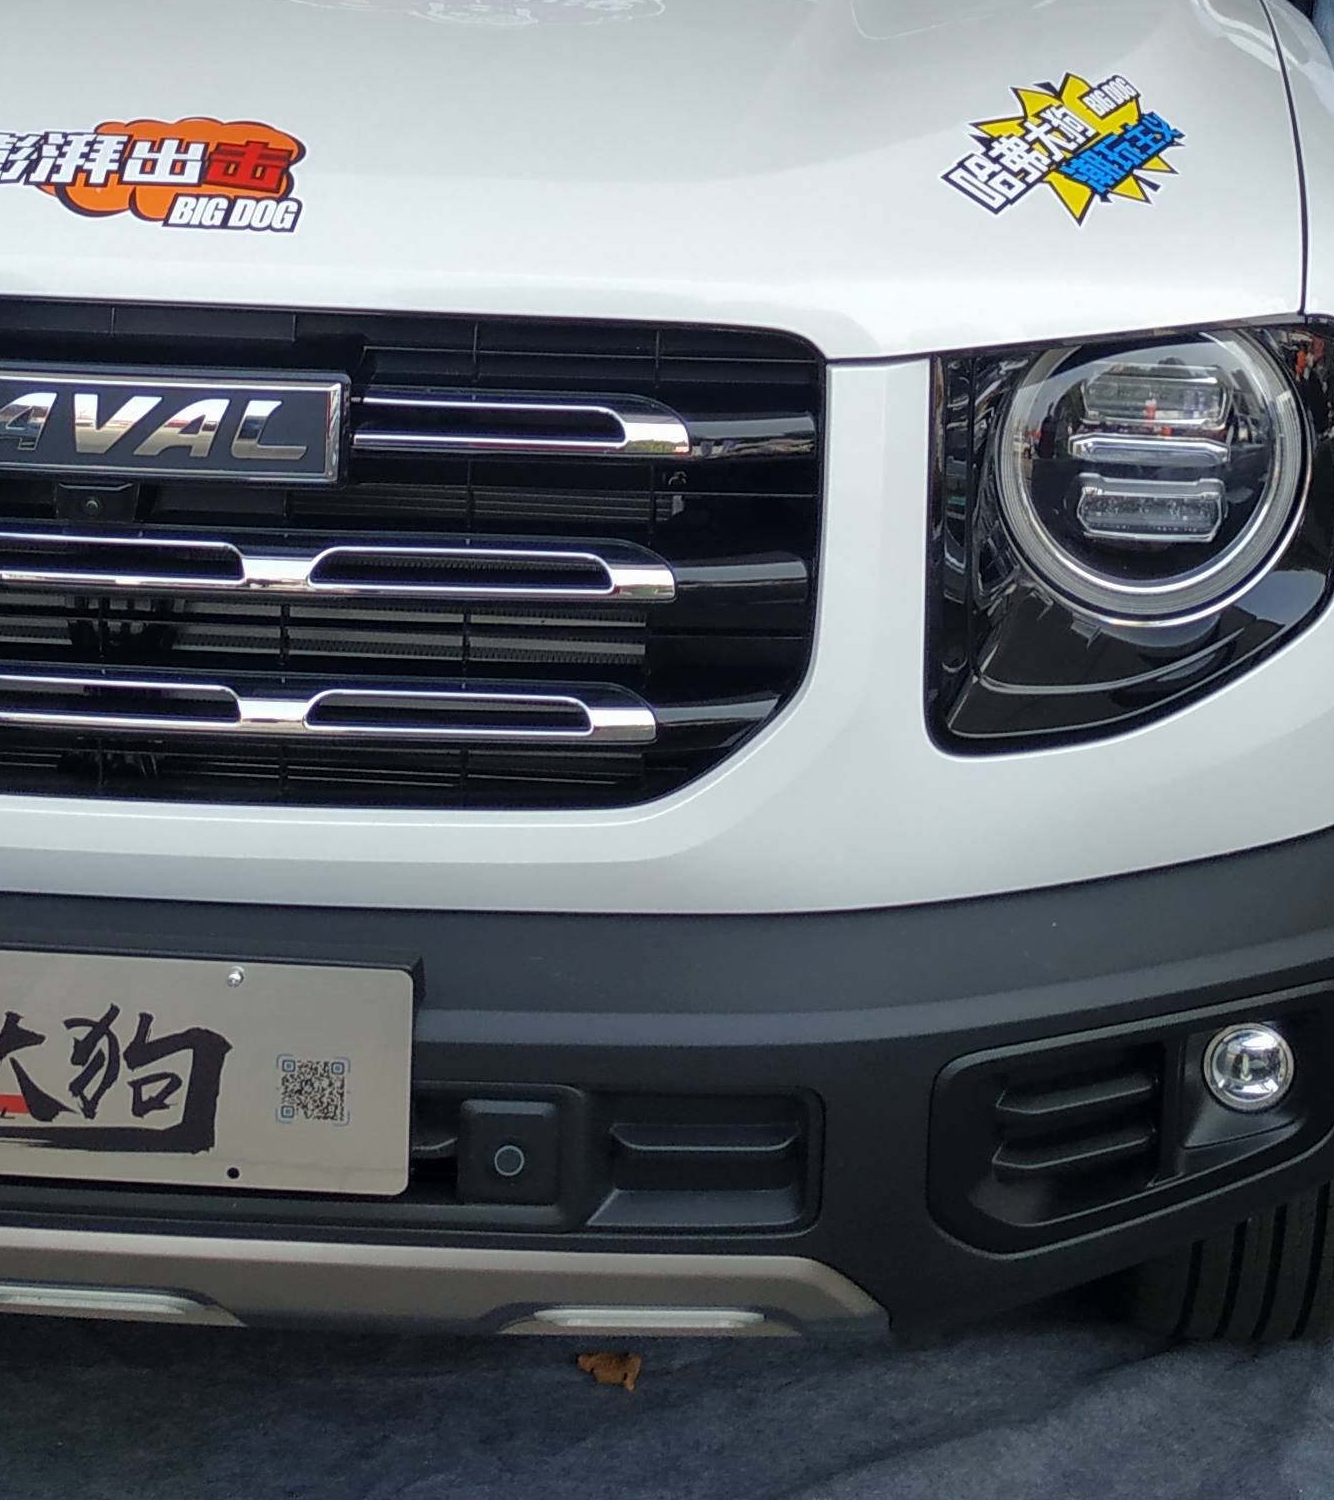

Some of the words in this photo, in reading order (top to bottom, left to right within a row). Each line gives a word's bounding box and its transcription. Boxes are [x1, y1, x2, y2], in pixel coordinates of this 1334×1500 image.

[947, 105, 1099, 210] 哈弗大狗
[170, 195, 228, 228] BIG
[230, 198, 297, 231] DOG
